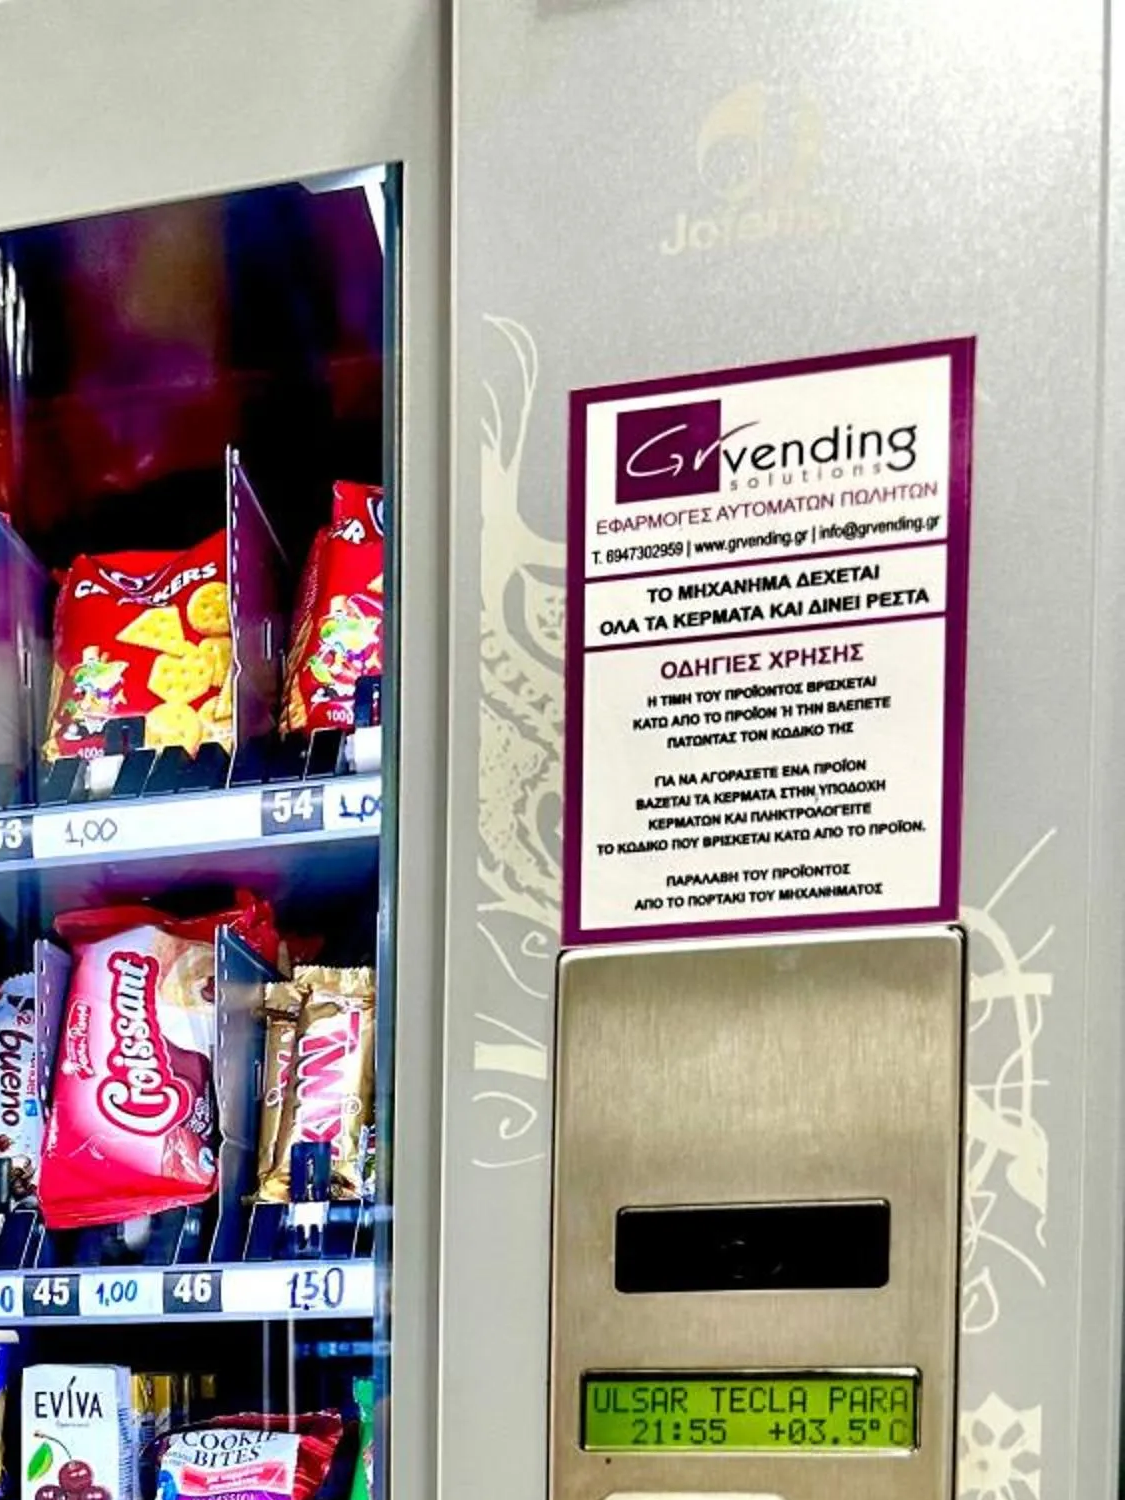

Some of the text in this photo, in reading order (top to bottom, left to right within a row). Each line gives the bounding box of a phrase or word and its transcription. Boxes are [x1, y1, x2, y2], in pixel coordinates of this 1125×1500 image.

[730, 462, 882, 491] solutions
[595, 482, 937, 535] ΕΦΑΡΜΟΓΕΣ ΑΥΤΟΜΑΤΩΝ ΠΩΛΗΤΩΝ
[605, 541, 683, 563] 6947302959
[693, 530, 808, 553] www.grvending.gr
[818, 515, 940, 540] info@grvending.gr
[645, 564, 880, 603] ΤΟ ΜΗΧΑΝΗΜΑ ΔΕΧΕΤΑΙ
[599, 588, 929, 636] ΟΛΑ ΤΑ ΚΕΡΜΑΤΑ ΚΑΙ ΔΙΝΕΙ ΡΕΣΤΑ
[659, 643, 863, 679] ΟΔΗΓΙΕΣ ΧΡΗΣΗΣ
[632, 715, 668, 730] ΚΑΤΩ
[670, 712, 700, 726] ΑΠΟ
[702, 711, 722, 724] ΤΟ
[723, 705, 777, 722] ΠΡΟΪΟΝ
[795, 701, 824, 716] ΤΗΝ
[826, 695, 891, 713] ΒΛΕΠΕΤΕ
[646, 695, 657, 708] Η
[659, 692, 692, 706] ΤΙΜΗ
[694, 689, 721, 703] ΤΟΥ
[739, 729, 768, 742] ΤΟΝ
[770, 723, 825, 739] ΚΩΔΙΚΟ
[826, 720, 854, 734] ΤΗΣ
[653, 774, 676, 787] ΓΙΑ
[677, 772, 697, 785] ΝΑ
[781, 763, 810, 777] ΕΝΑ
[813, 758, 866, 774] ΠΡΟΪΟΝ
[635, 779, 886, 810] ΒΑΖΕΤΑΙ ΤΑ ΚΕΡΜΑΤΑ ΣΤΗΝ ΥΠΟΔΟΧΗ
[64, 817, 118, 847] 1,00
[272, 791, 314, 823] 54
[723, 811, 747, 824] ΚΑΙ
[596, 842, 615, 855] ΤΟ
[616, 839, 668, 854] ΚΩΔΙΚΟ
[670, 836, 699, 850] ΠΟΥ
[773, 828, 810, 842] ΚΑΤΩ
[812, 825, 843, 839] ΑΠΟ
[846, 824, 866, 837] ΤΟ
[868, 820, 925, 834] ΠΡΟΪΟΝ.
[741, 868, 769, 881] ΤΟΥ
[633, 897, 663, 910] ΑΠΟ
[665, 895, 685, 908] ΤΟ
[686, 891, 745, 906] ΠΟΡΤΑΚΙ
[747, 889, 775, 902] ΤΟΥ
[100, 952, 181, 1130] Croissant
[32, 1278, 70, 1306] 45
[173, 1273, 212, 1302] 46
[592, 1386, 909, 1414] ULSAR TECLA PARA
[631, 1418, 728, 1445] 21:55
[193, 1445, 262, 1467] BITES
